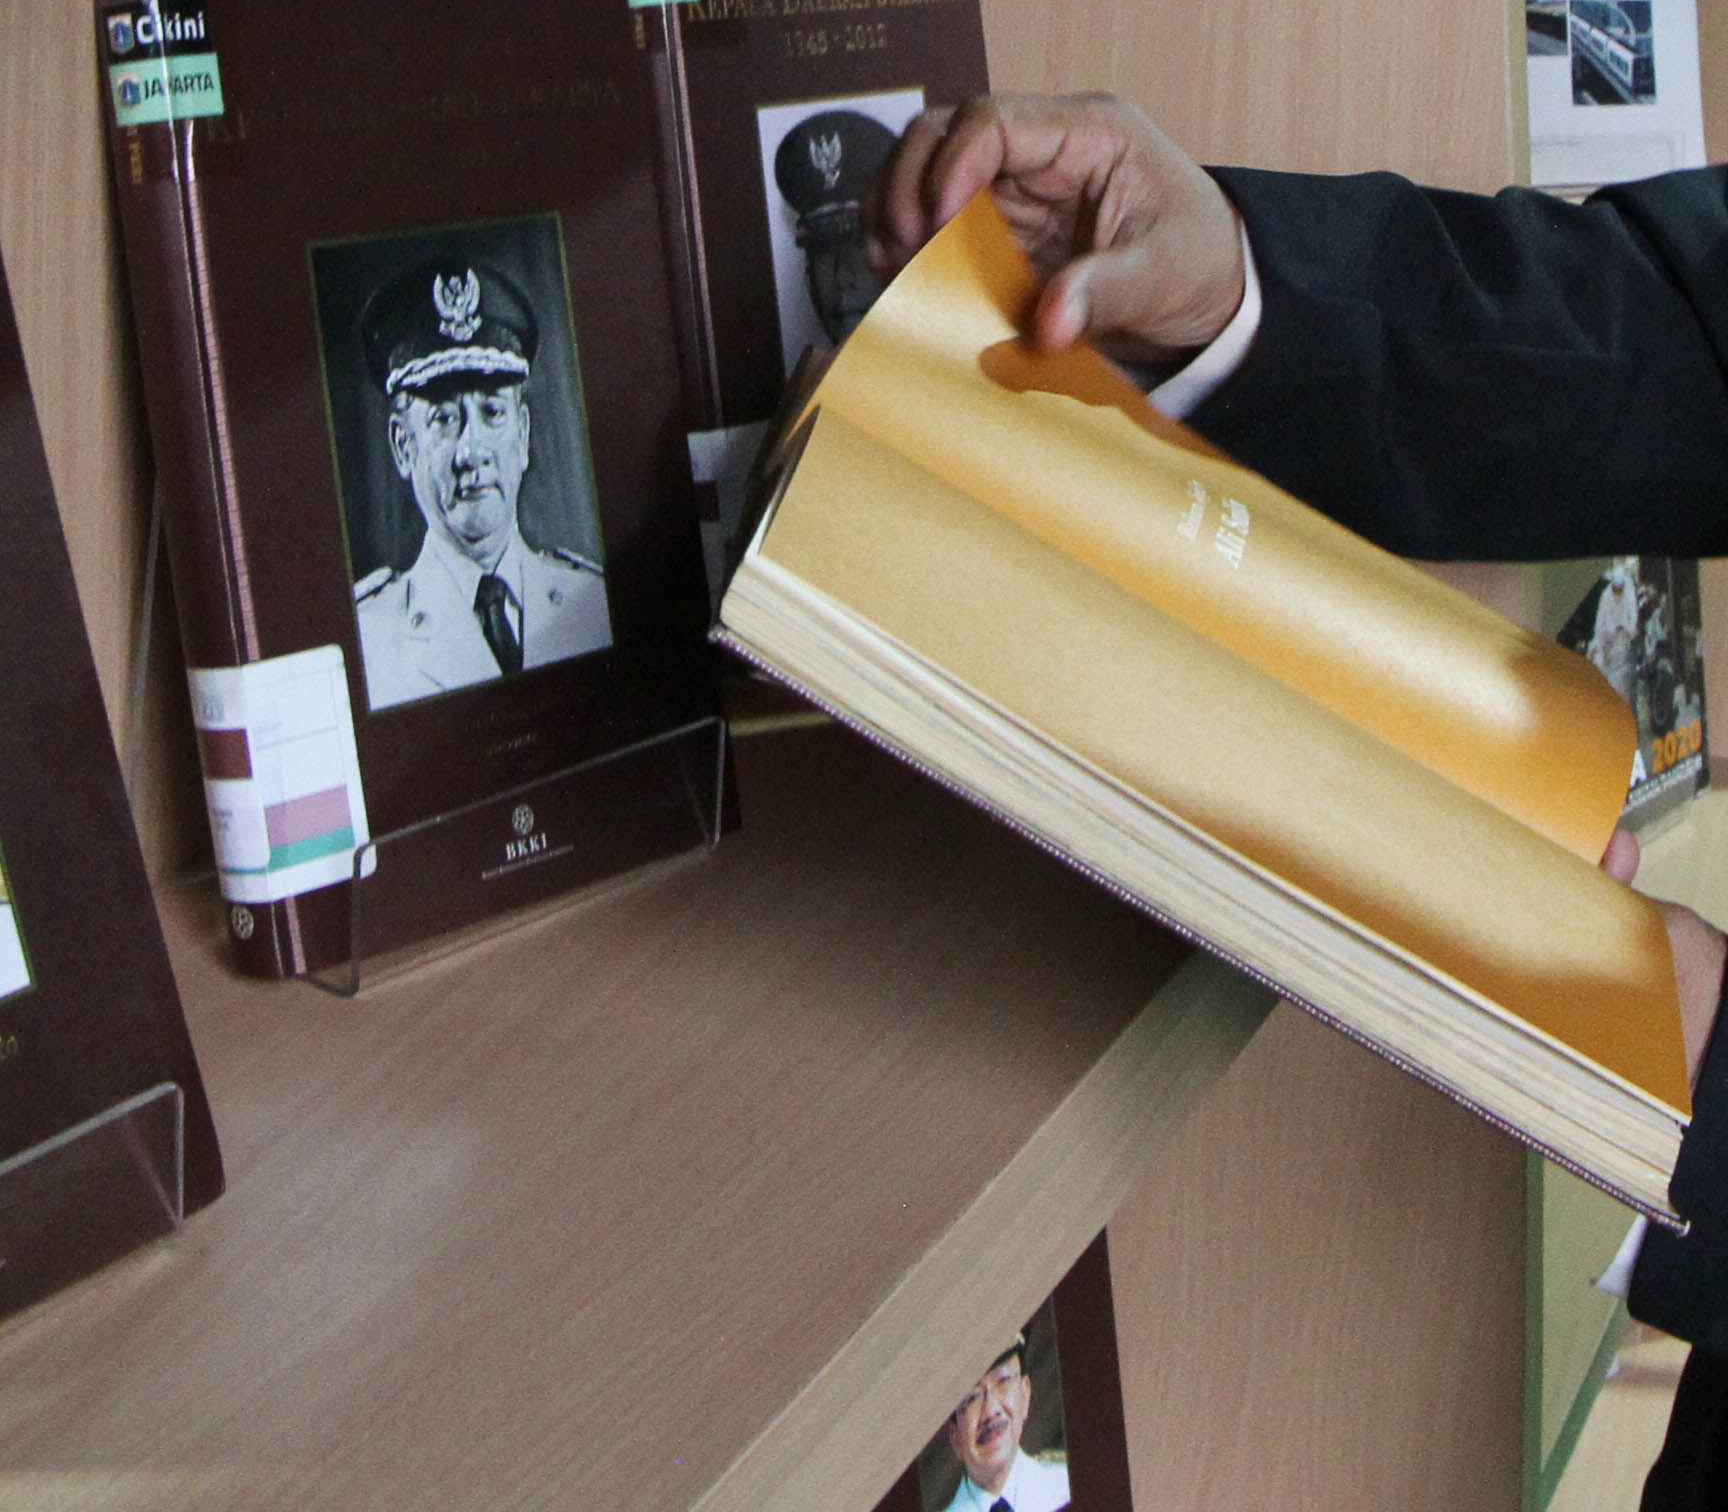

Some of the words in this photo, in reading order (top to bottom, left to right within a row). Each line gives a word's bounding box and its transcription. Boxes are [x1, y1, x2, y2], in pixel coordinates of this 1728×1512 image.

[136, 11, 206, 45] Ckini
[144, 71, 215, 99] JAARTA
[1651, 719, 1703, 774] 2020
[505, 831, 549, 862] BKKI
